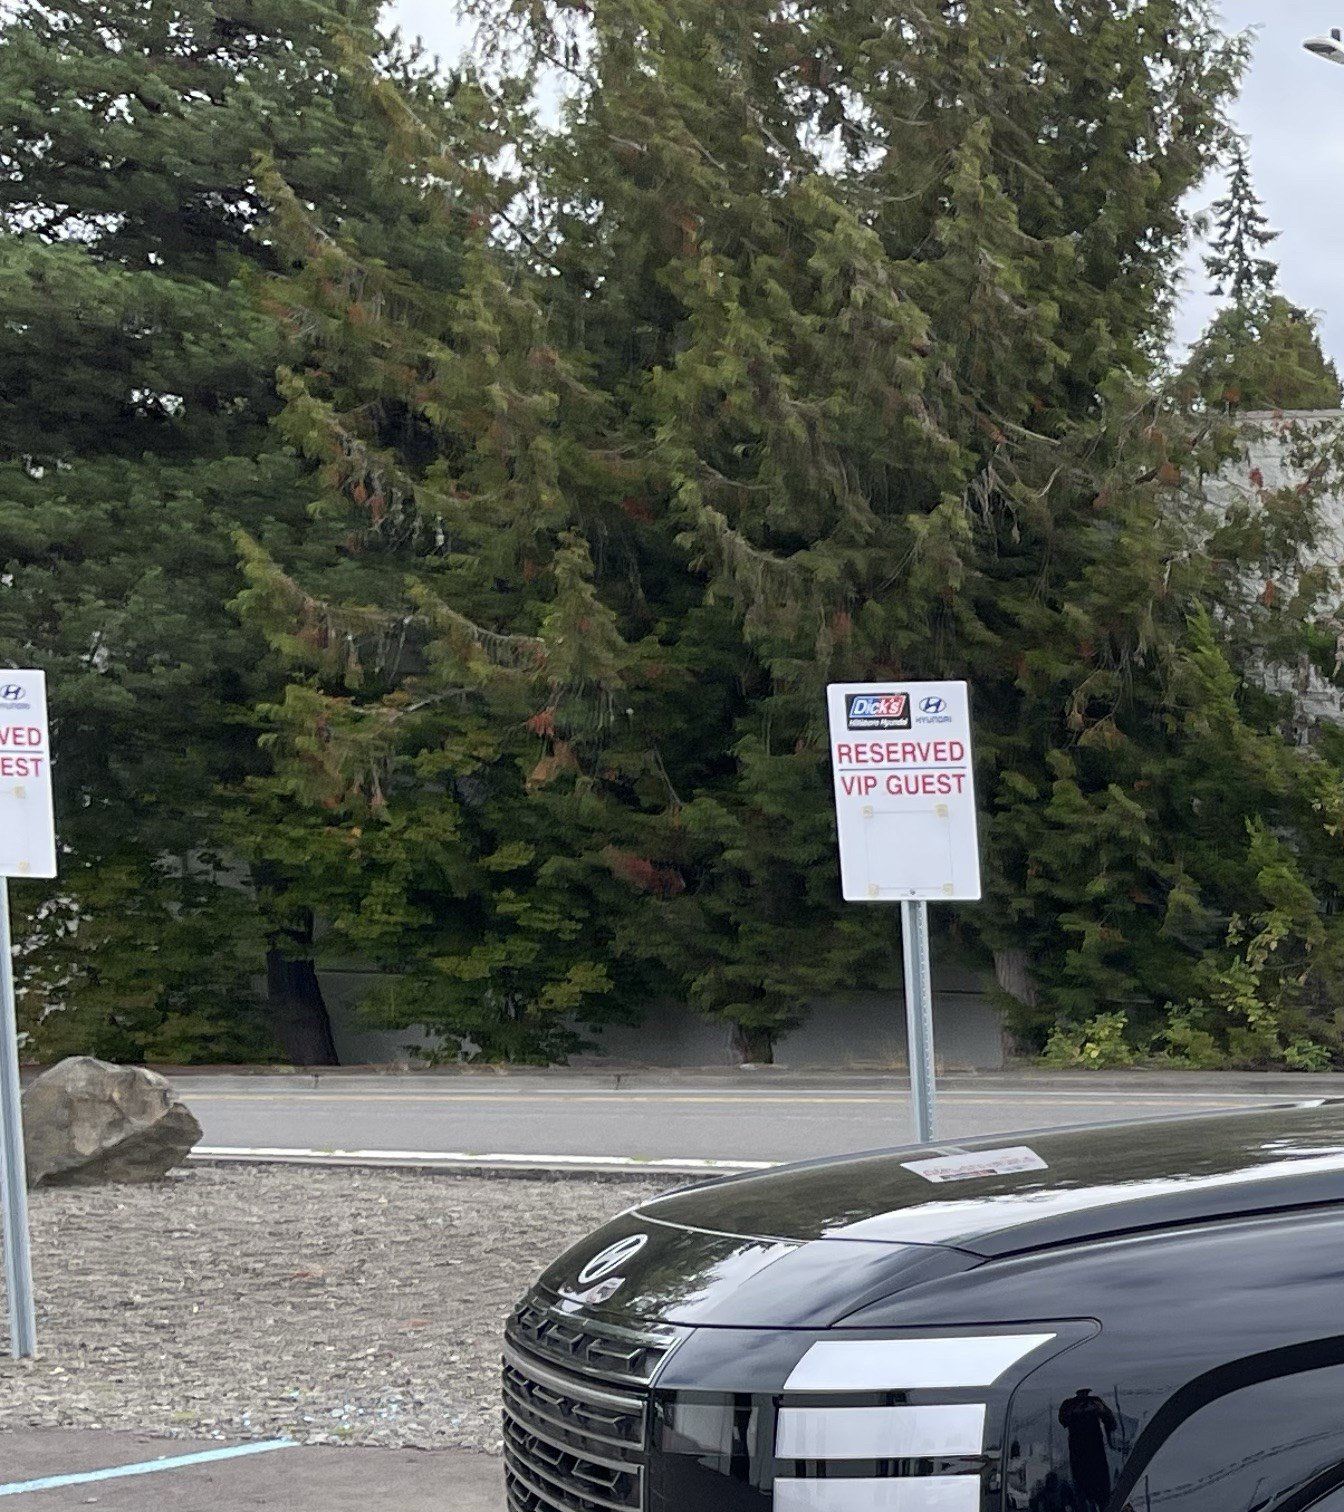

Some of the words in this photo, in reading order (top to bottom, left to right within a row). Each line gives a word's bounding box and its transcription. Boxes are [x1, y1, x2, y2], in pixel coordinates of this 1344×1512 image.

[837, 741, 965, 764] RESERVED
[841, 775, 878, 796] VIP
[886, 774, 966, 795] GUEST
